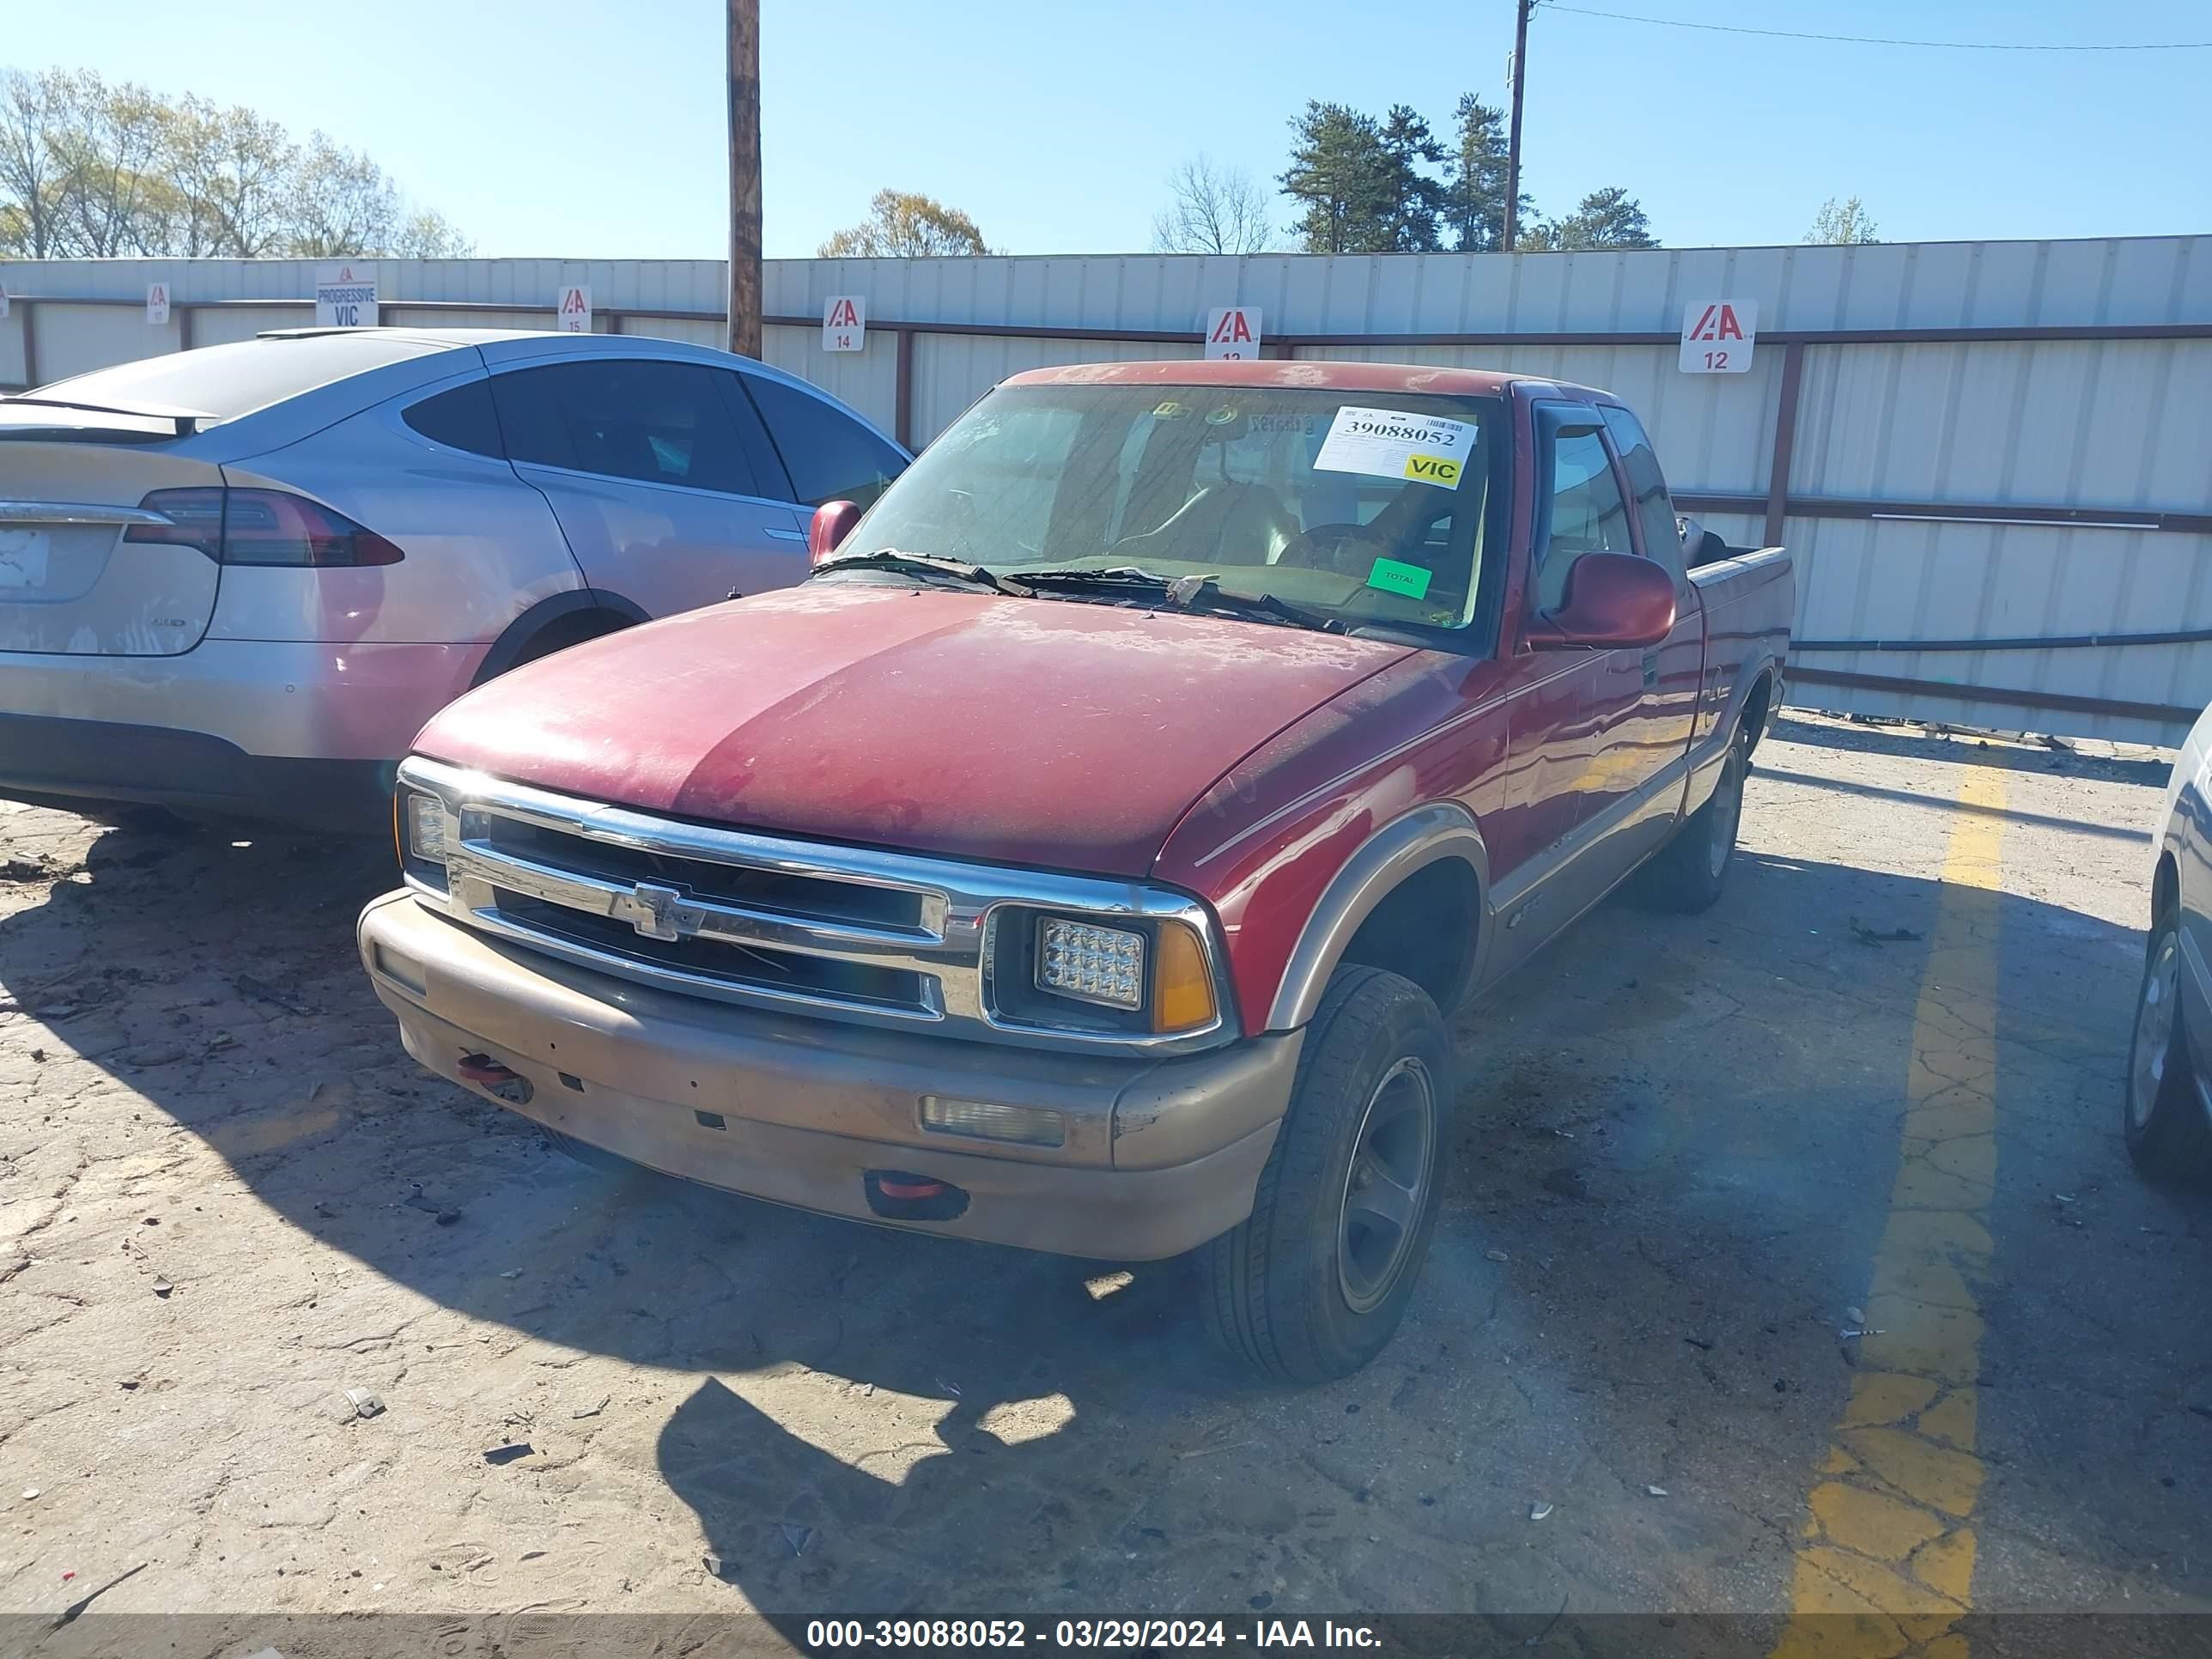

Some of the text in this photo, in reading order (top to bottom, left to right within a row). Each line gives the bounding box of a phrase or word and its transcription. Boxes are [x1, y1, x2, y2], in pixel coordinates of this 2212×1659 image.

[318, 288, 375, 303] PROGRESSIVE
[335, 306, 358, 326] VIC
[569, 321, 580, 332] 15
[836, 335, 850, 349] 14
[1705, 352, 1728, 369] 12
[1346, 421, 1455, 447] 39088052
[1412, 459, 1456, 479] VIC
[1386, 571, 1416, 585] TOTAL
